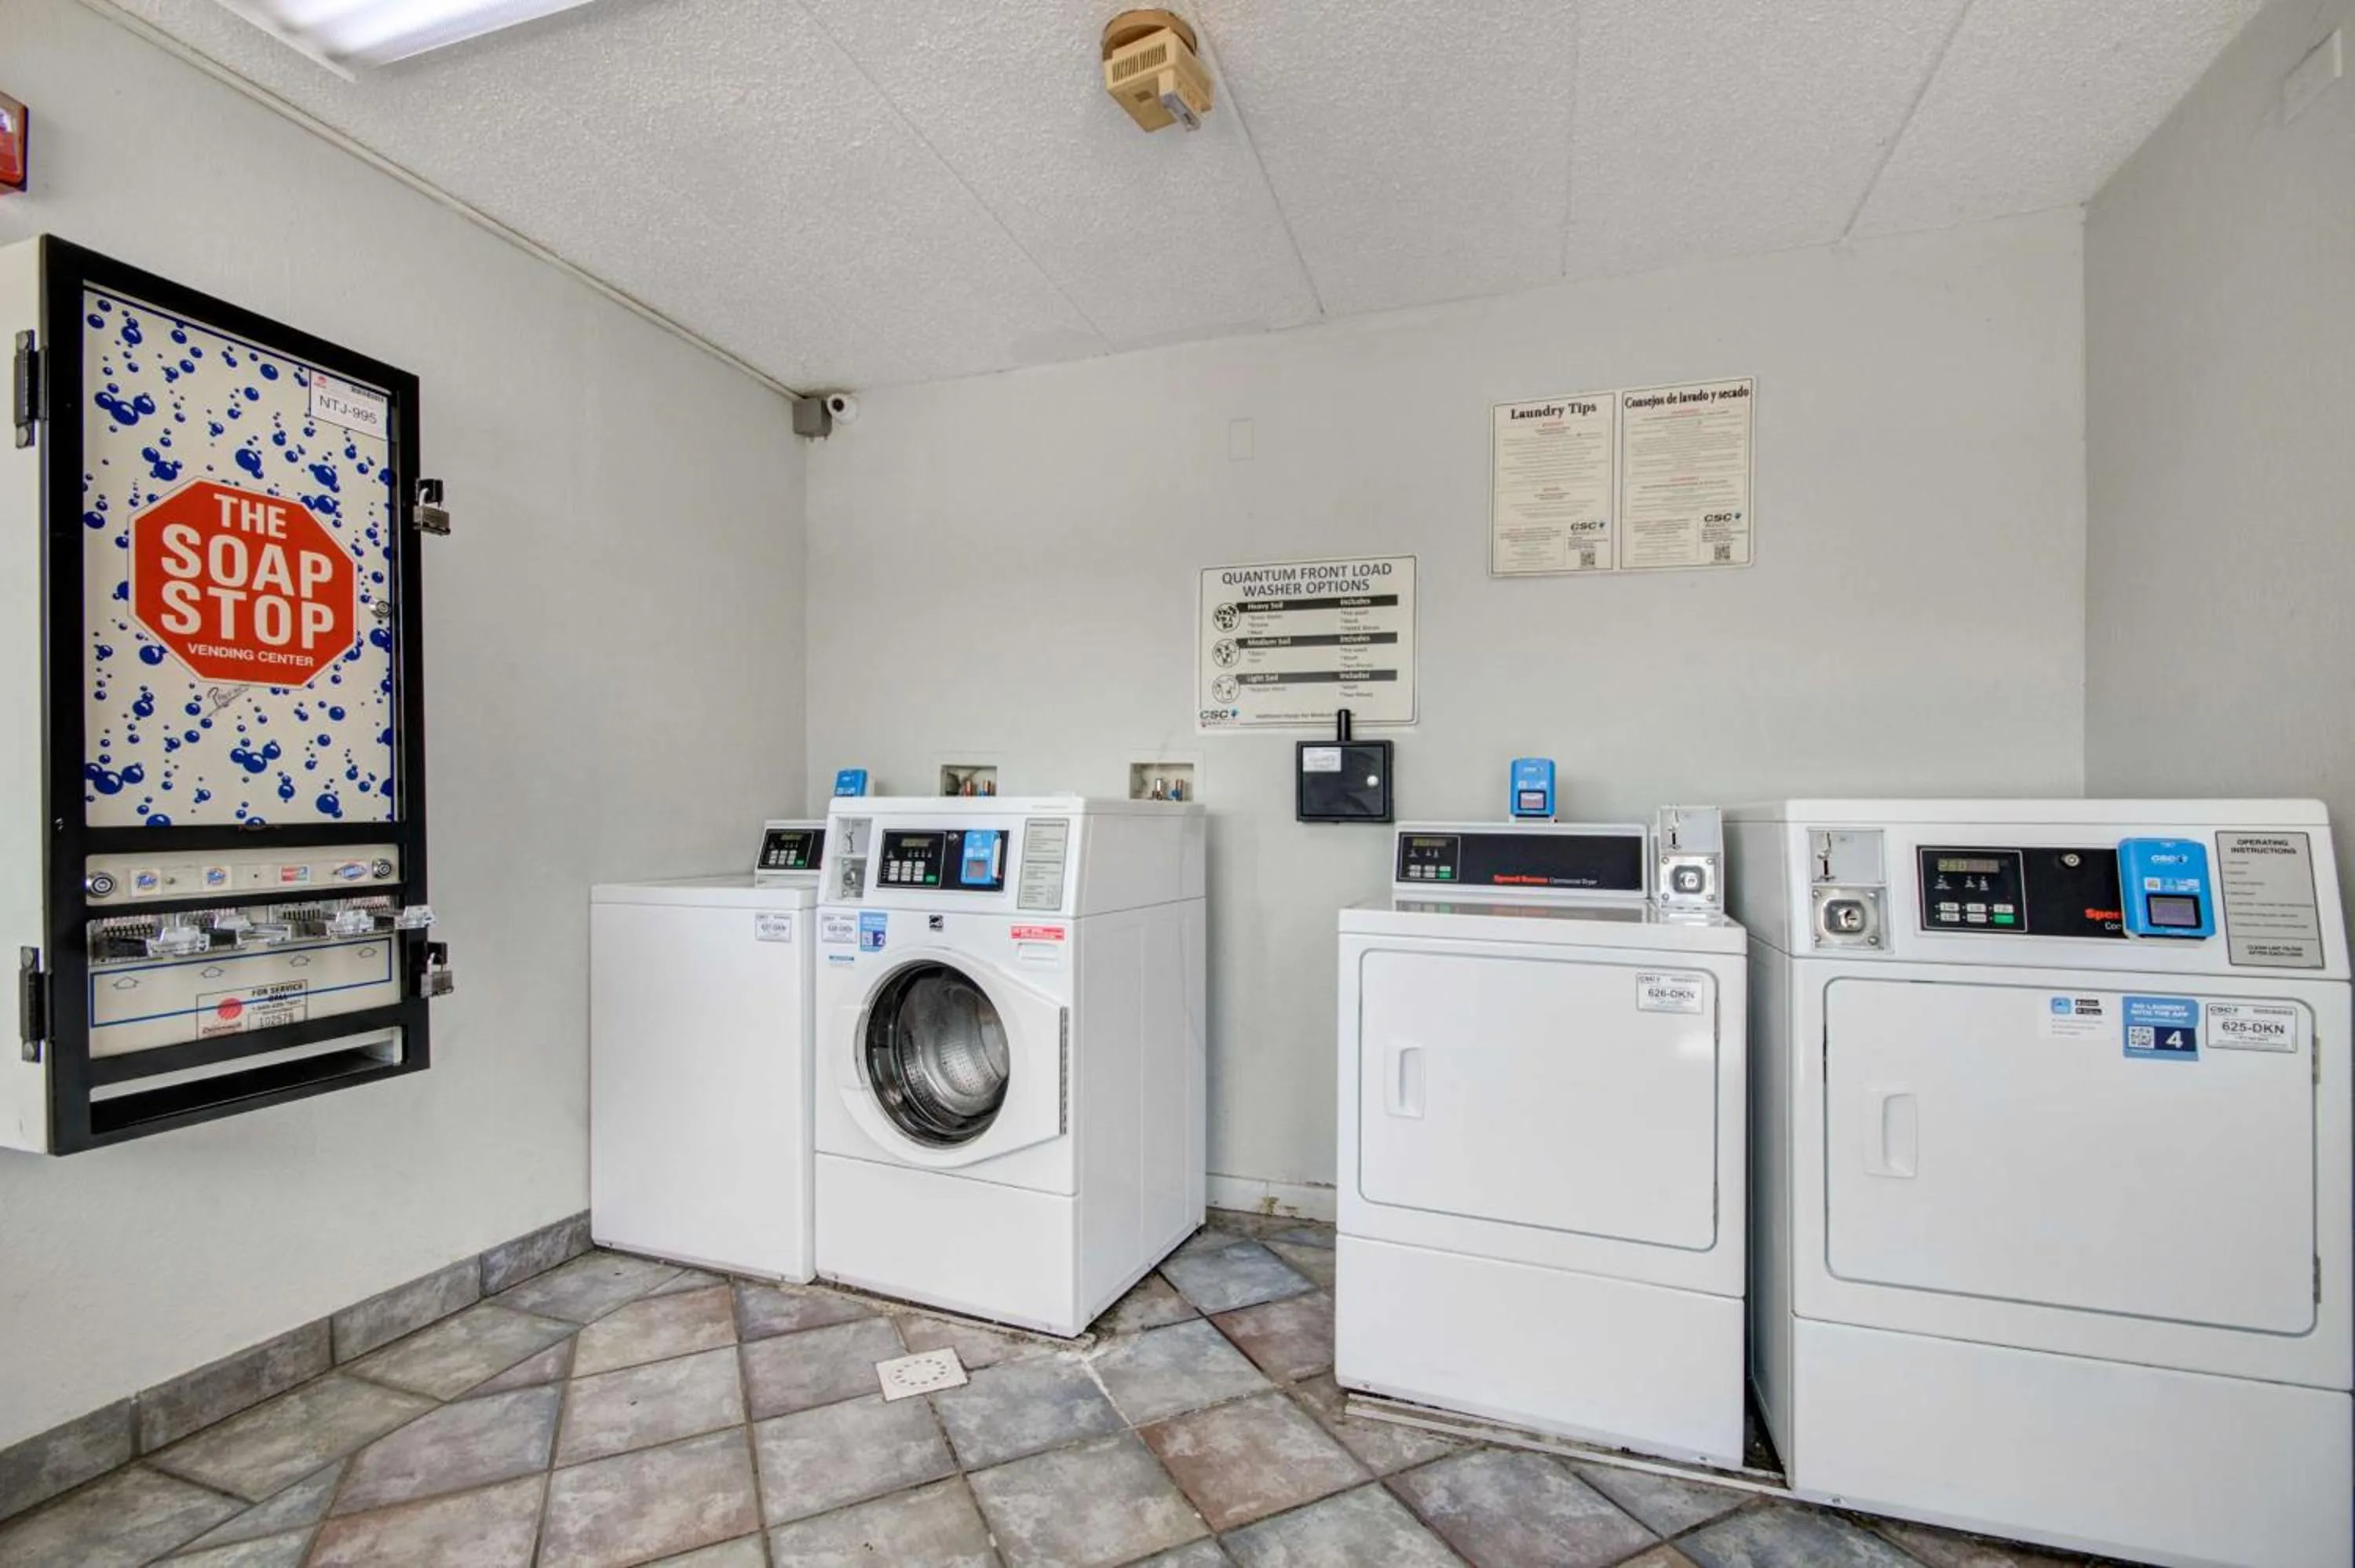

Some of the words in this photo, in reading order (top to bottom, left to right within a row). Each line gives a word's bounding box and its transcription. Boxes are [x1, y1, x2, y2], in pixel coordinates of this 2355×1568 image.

[1625, 395, 1664, 409] Consejos
[1667, 392, 1678, 403] de
[1679, 389, 1709, 403] lavado
[1711, 392, 1716, 403] y
[1718, 385, 1749, 399] secado
[1510, 405, 1565, 419] Laundry
[1568, 403, 1597, 416] Tips
[214, 493, 287, 539] THE
[161, 523, 333, 599] SOAP
[1222, 569, 1295, 585] QUANTUM
[1301, 565, 1348, 579] FRONT
[1352, 563, 1392, 577] LOAD
[1243, 583, 1302, 597] WASHER
[1305, 579, 1370, 594] OPTIONS
[161, 580, 334, 650] STOP
[188, 643, 254, 661] VENDING
[258, 651, 313, 666] CENTER
[270, 982, 303, 994] SERVICE
[2222, 1021, 2284, 1034] 625-DKN
[2165, 1030, 2184, 1048] 4
